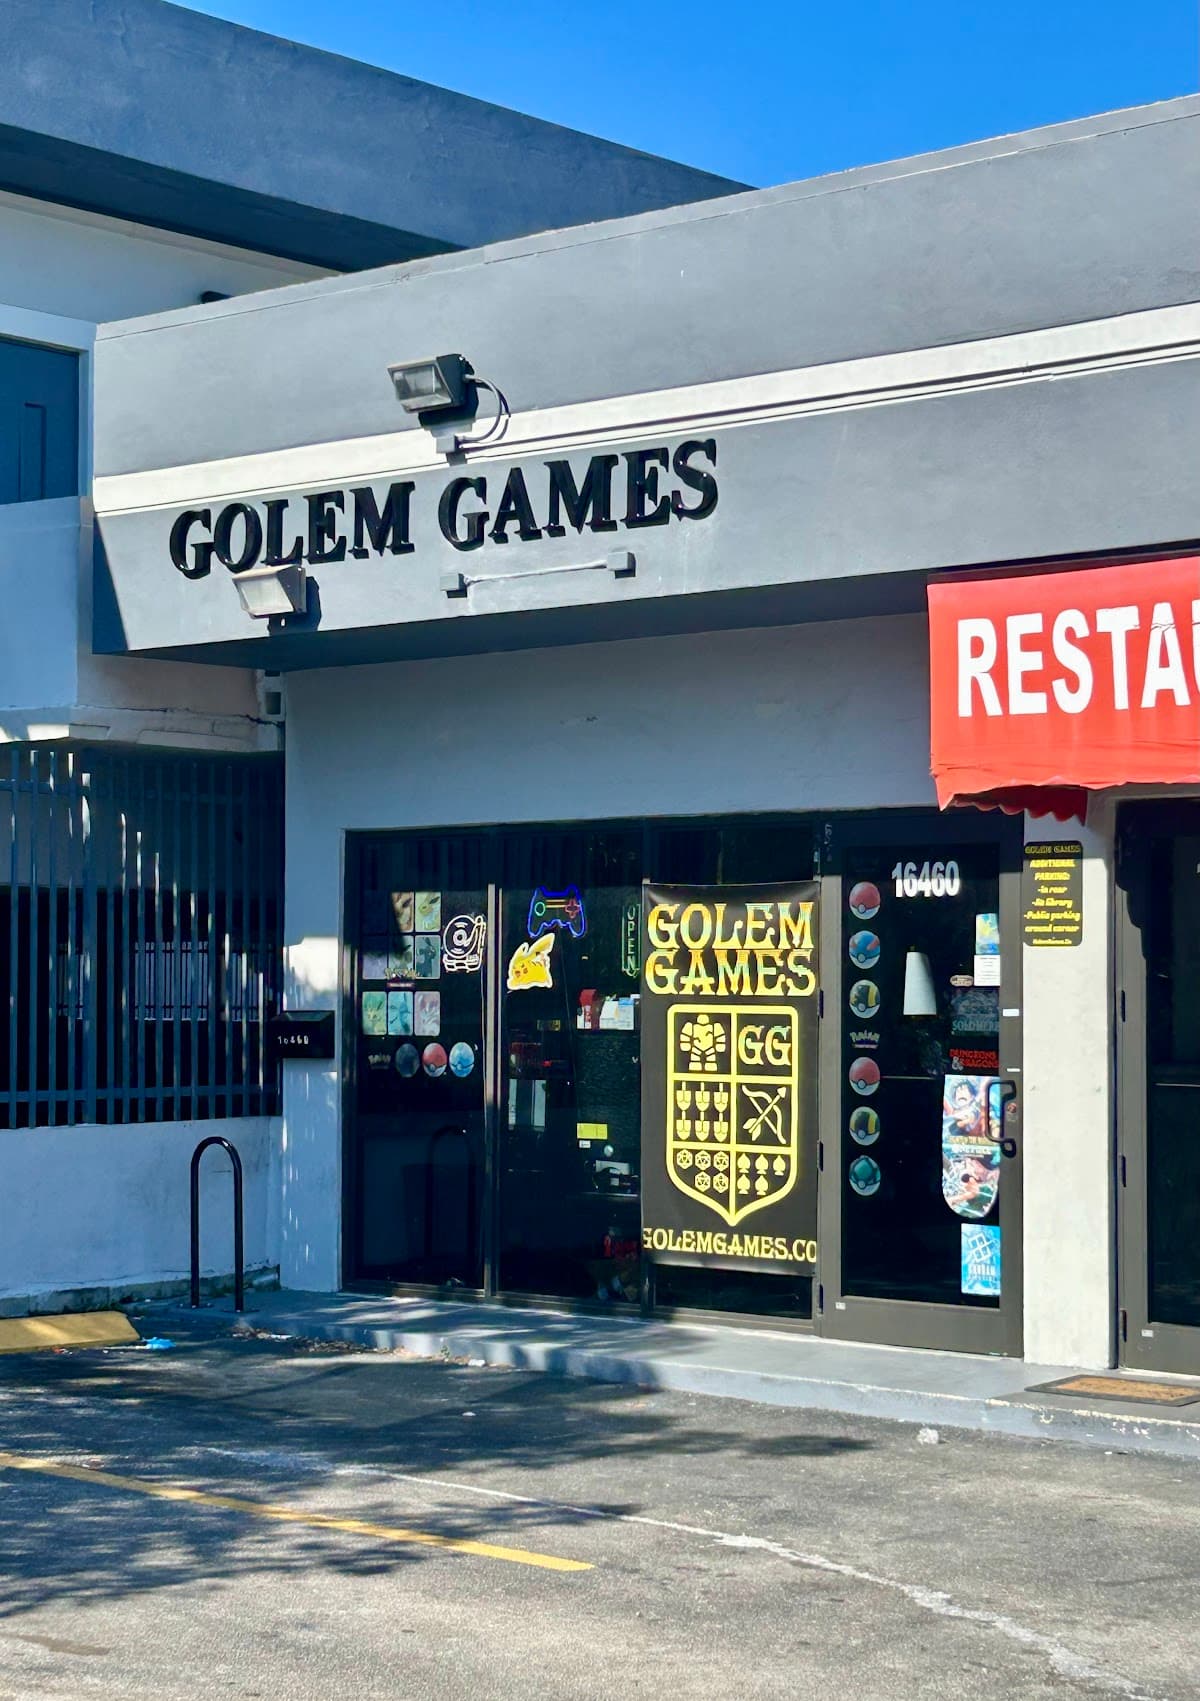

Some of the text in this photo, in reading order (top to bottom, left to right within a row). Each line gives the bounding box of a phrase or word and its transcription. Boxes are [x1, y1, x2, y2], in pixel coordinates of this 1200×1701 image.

[169, 439, 719, 580] GOLEM GAMES
[957, 599, 1200, 718] RESTA
[891, 860, 960, 898] 16460
[647, 901, 815, 949] GOLEM
[645, 948, 816, 997] GAMES
[738, 1025, 792, 1066] GG
